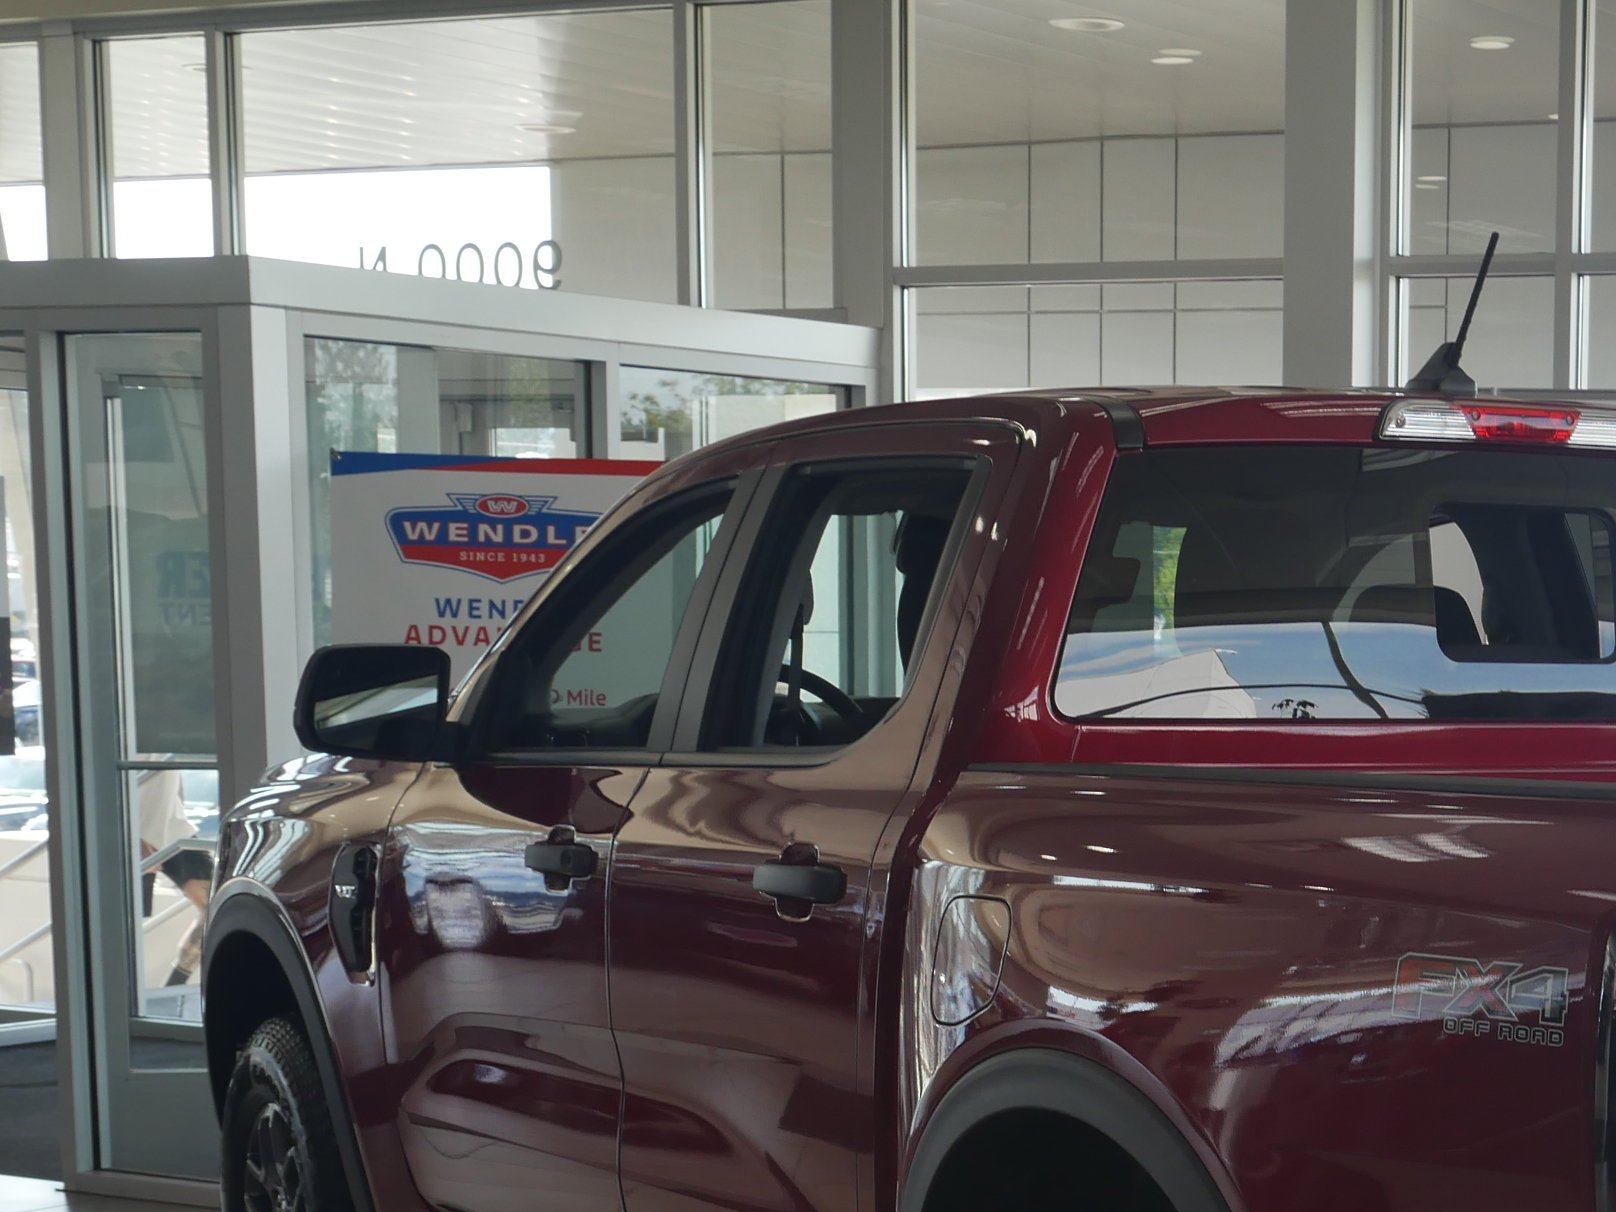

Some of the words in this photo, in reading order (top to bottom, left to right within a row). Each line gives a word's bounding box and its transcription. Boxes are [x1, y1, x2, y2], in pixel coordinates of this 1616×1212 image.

[459, 551, 505, 562] SINCE
[512, 552, 546, 563] 1943
[434, 597, 525, 620] WEN
[567, 688, 607, 706] Mile
[1391, 951, 1569, 1026] FX4
[1443, 1017, 1490, 1037] OFF
[1498, 1023, 1564, 1047] ROAD
